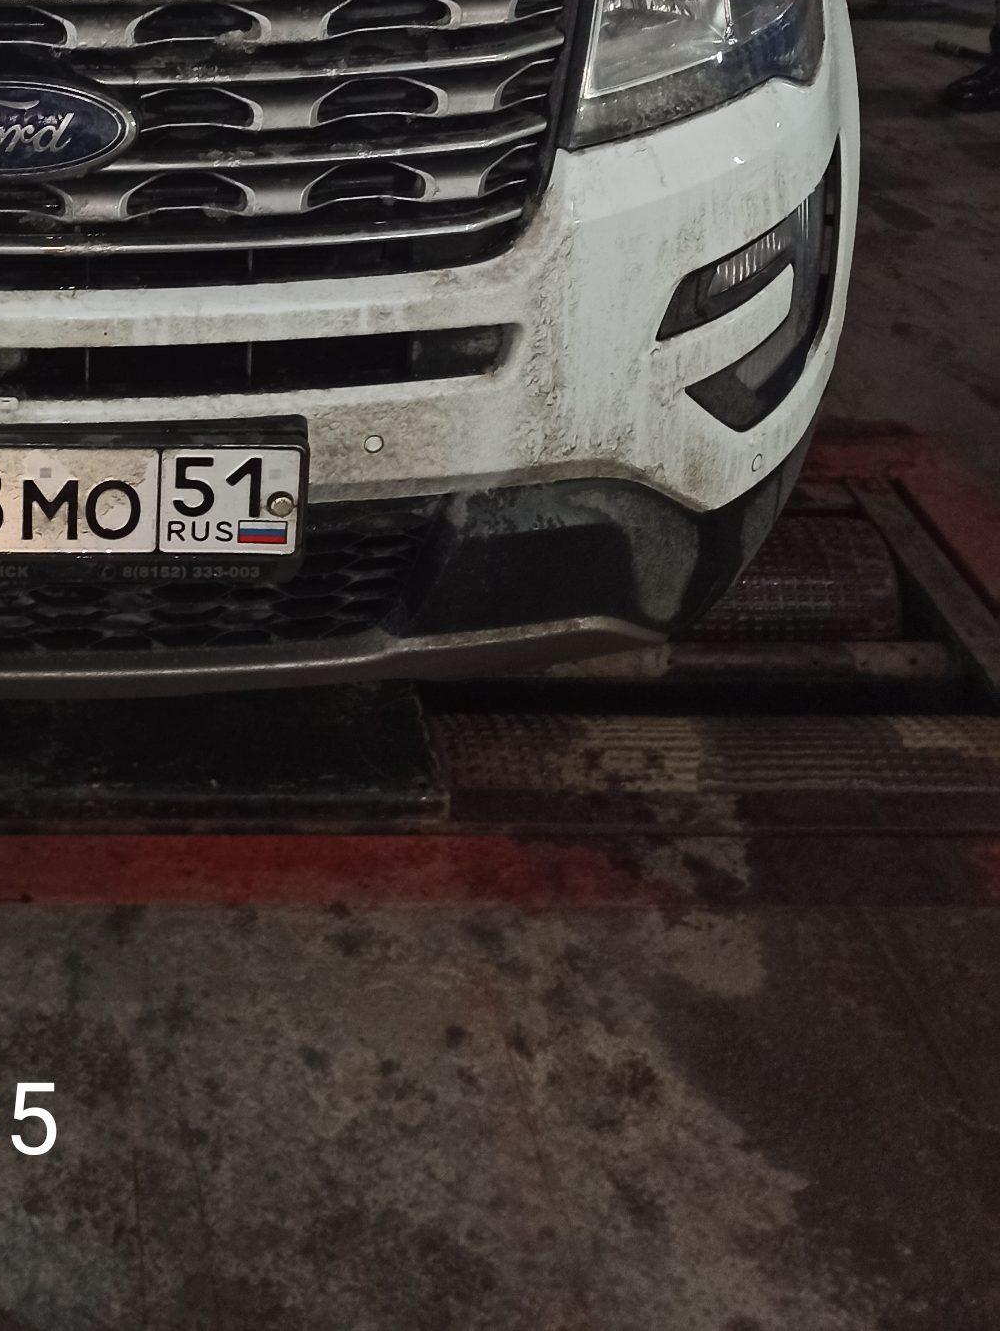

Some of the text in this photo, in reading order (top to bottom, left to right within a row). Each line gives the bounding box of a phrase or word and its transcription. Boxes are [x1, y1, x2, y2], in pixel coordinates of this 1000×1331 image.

[172, 456, 262, 518] 51
[167, 521, 234, 543] RUS
[122, 565, 188, 580] 8(8152)
